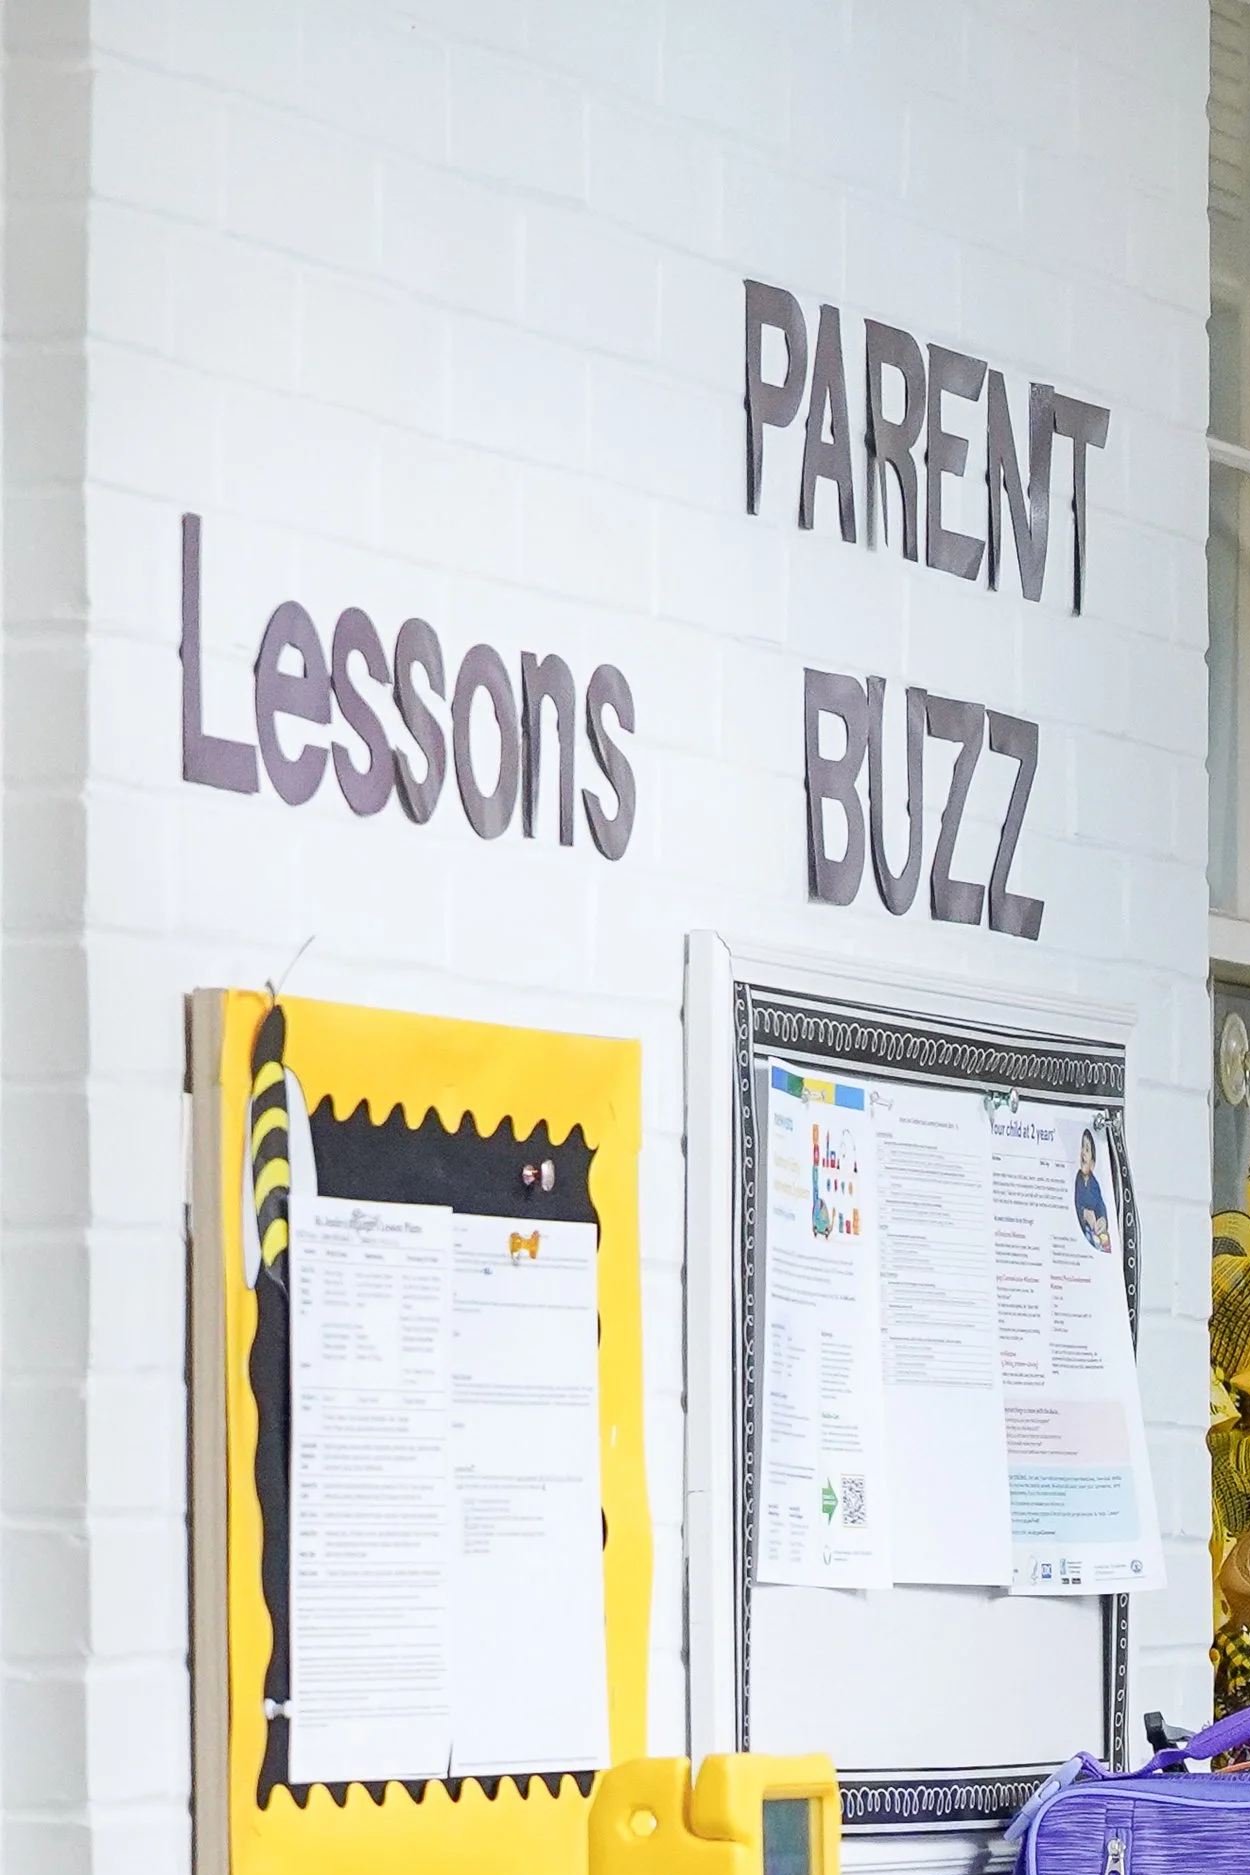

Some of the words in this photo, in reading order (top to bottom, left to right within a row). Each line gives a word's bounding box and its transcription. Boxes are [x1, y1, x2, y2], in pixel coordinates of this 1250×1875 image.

[744, 279, 1110, 617] PARENT
[180, 512, 636, 860] Lessons
[804, 668, 1045, 941] BUZZ
[1007, 1120, 1022, 1137] child
[1023, 1126, 1030, 1139] at
